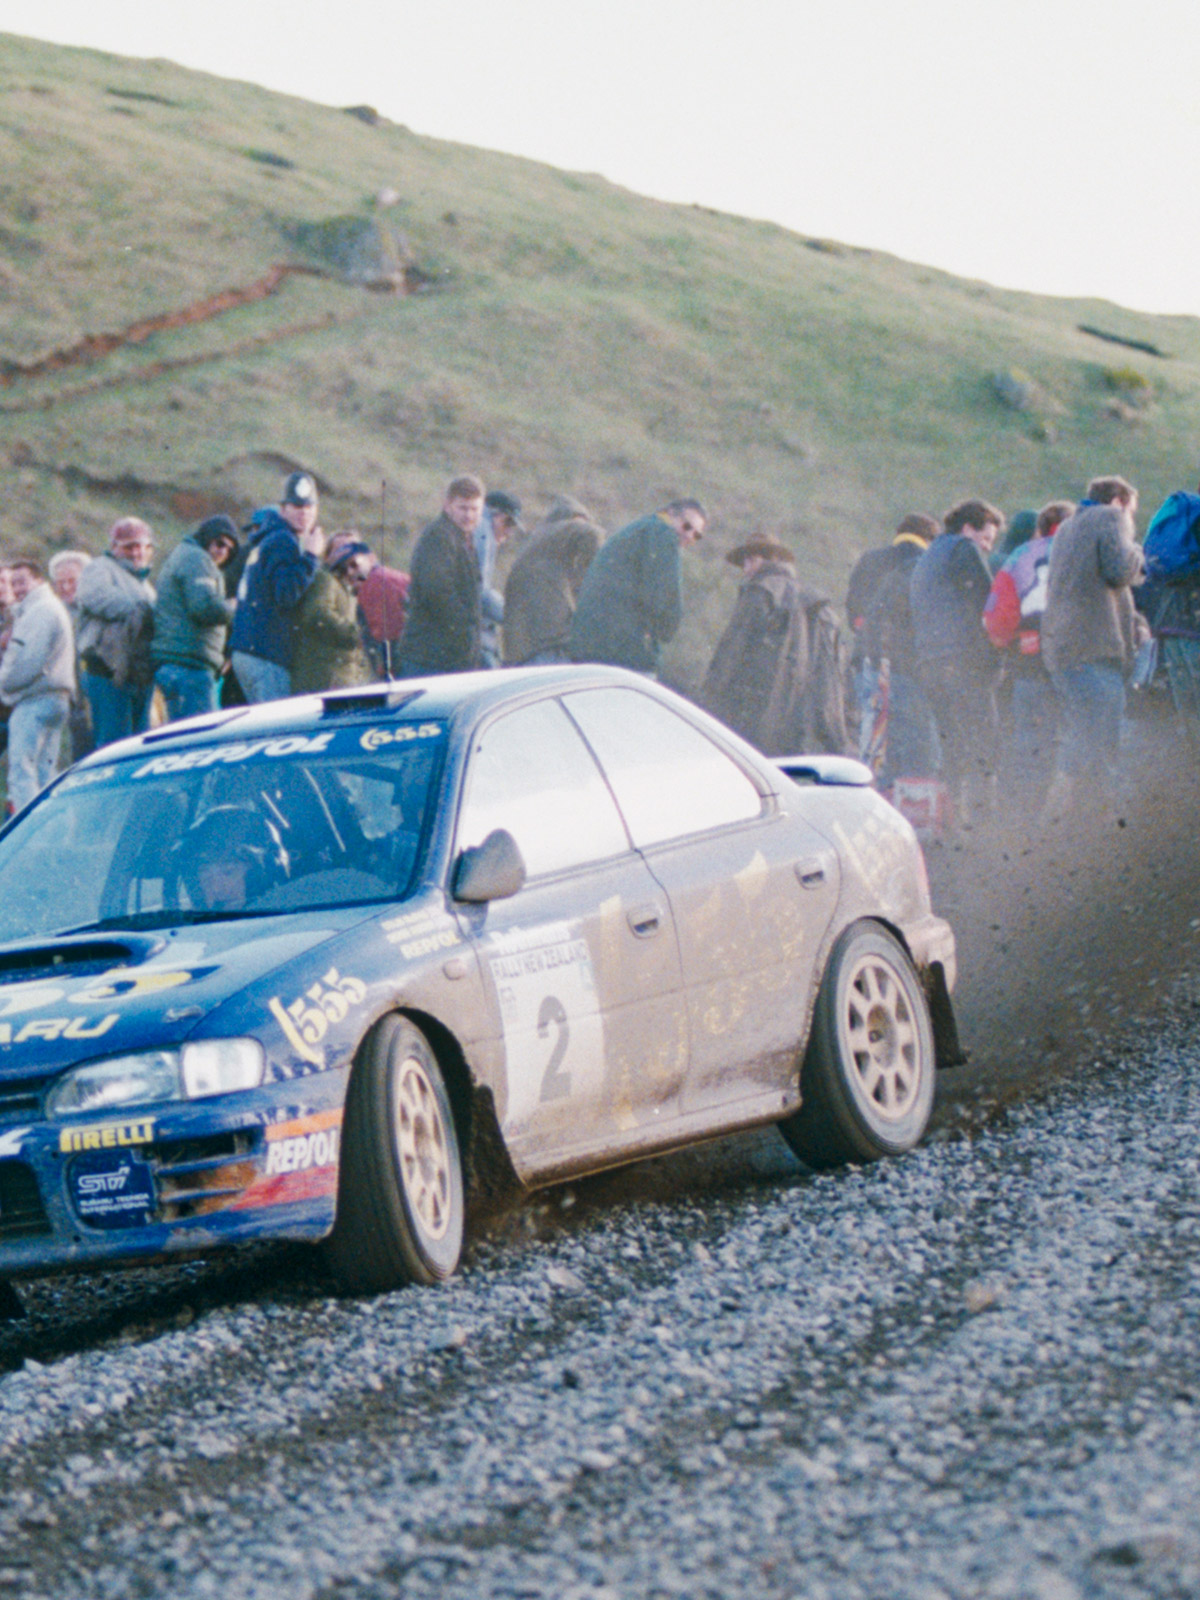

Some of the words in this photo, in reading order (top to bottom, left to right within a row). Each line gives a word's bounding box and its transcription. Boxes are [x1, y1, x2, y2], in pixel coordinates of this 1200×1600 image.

[131, 733, 336, 779] REPSOL
[360, 724, 442, 751] 555
[284, 966, 368, 1044] 555
[536, 995, 572, 1102] 2
[60, 1116, 155, 1152] PIRELLI
